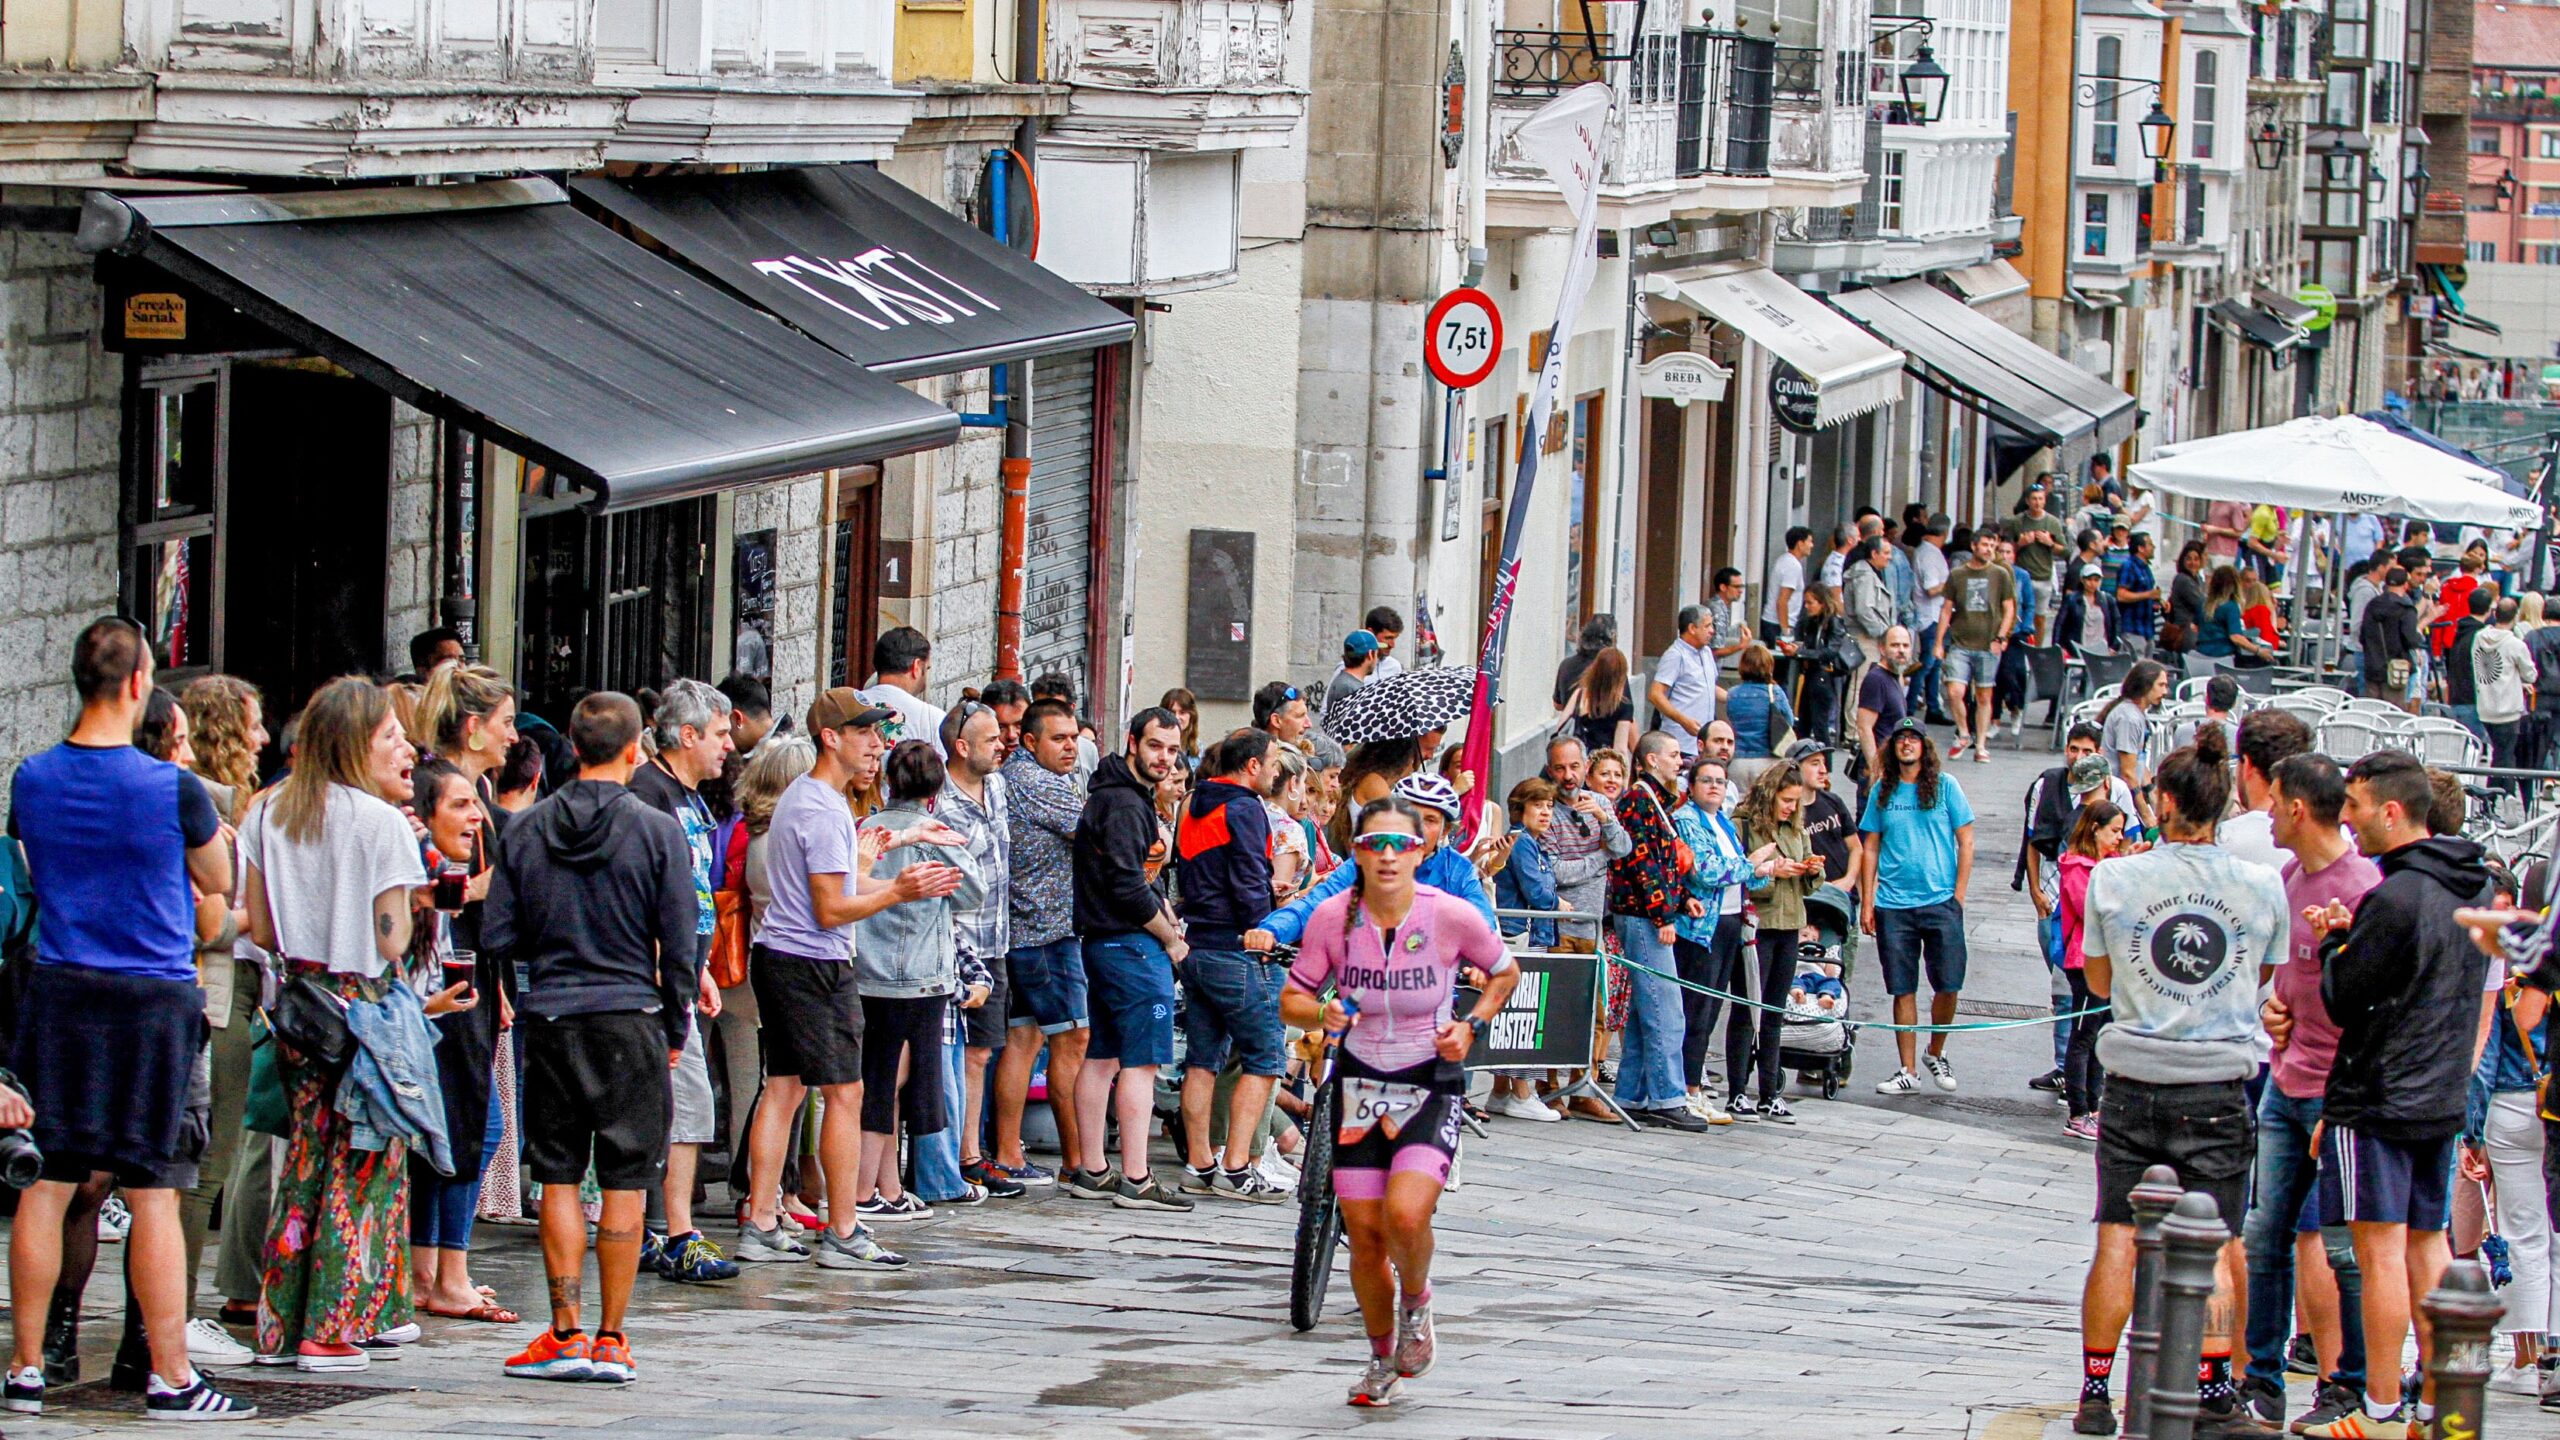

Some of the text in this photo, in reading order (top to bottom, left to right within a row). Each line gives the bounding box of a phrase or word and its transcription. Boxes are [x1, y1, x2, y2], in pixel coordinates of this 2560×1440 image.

[127, 298, 184, 311] Urrezko
[132, 311, 177, 323] Sariak
[1445, 321, 1487, 357] 7,5t
[1664, 371, 1703, 384] BREDA
[885, 557, 900, 583] 1
[1802, 818, 1831, 836] urley
[2186, 892, 2233, 917] Globe
[1339, 964, 1438, 992] JORQUERA
[2137, 966, 2195, 1007] Nineteen
[1489, 1012, 1538, 1050] GASTEIZ
[2088, 1357, 2112, 1368] DU
